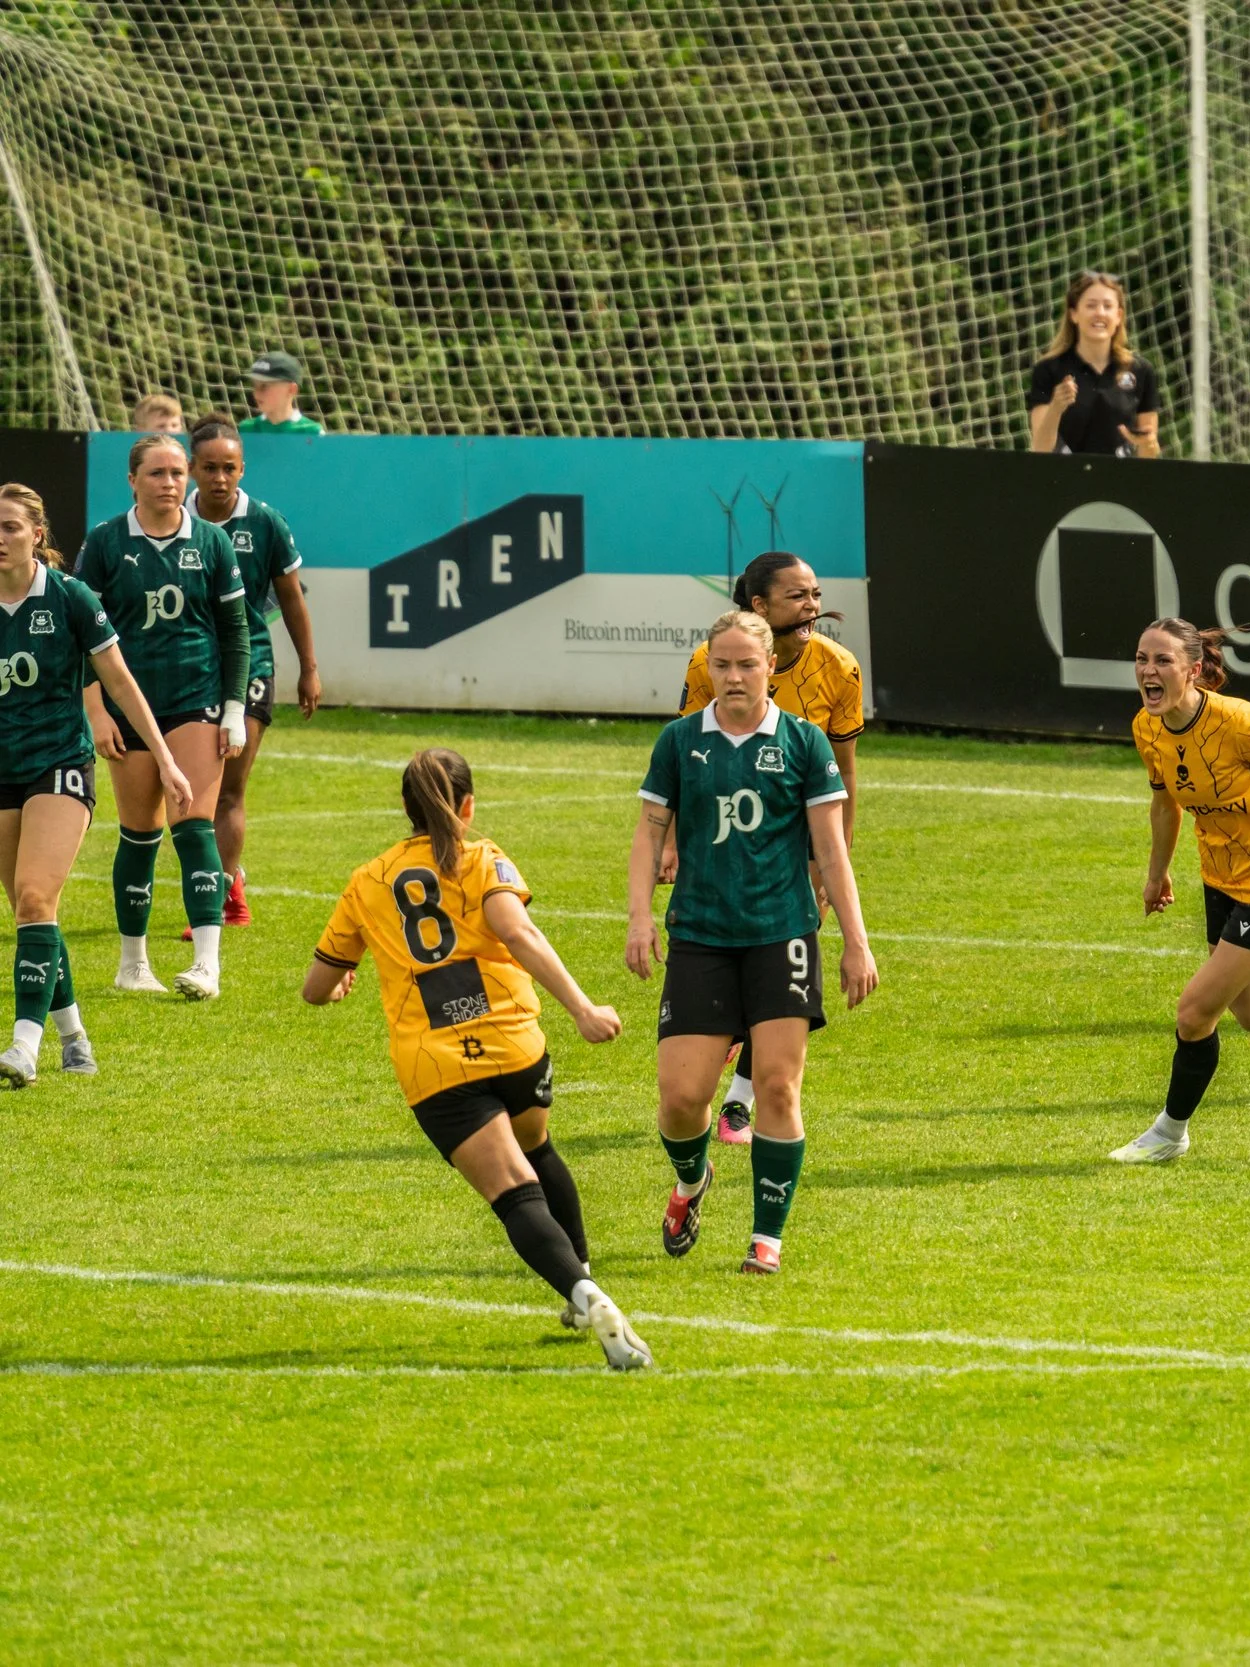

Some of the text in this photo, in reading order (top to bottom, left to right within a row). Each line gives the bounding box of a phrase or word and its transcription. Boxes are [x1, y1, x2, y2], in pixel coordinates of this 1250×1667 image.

[386, 511, 564, 633] IREN
[565, 618, 621, 641] Bitcoin
[624, 621, 687, 649] mining,
[54, 769, 85, 797] 19
[393, 867, 457, 965] 8
[787, 938, 809, 979] 9
[21, 974, 46, 984] PAFC
[442, 992, 488, 1015] STONE
[452, 1004, 489, 1024] RIDGE
[762, 1193, 785, 1204] PAFC
